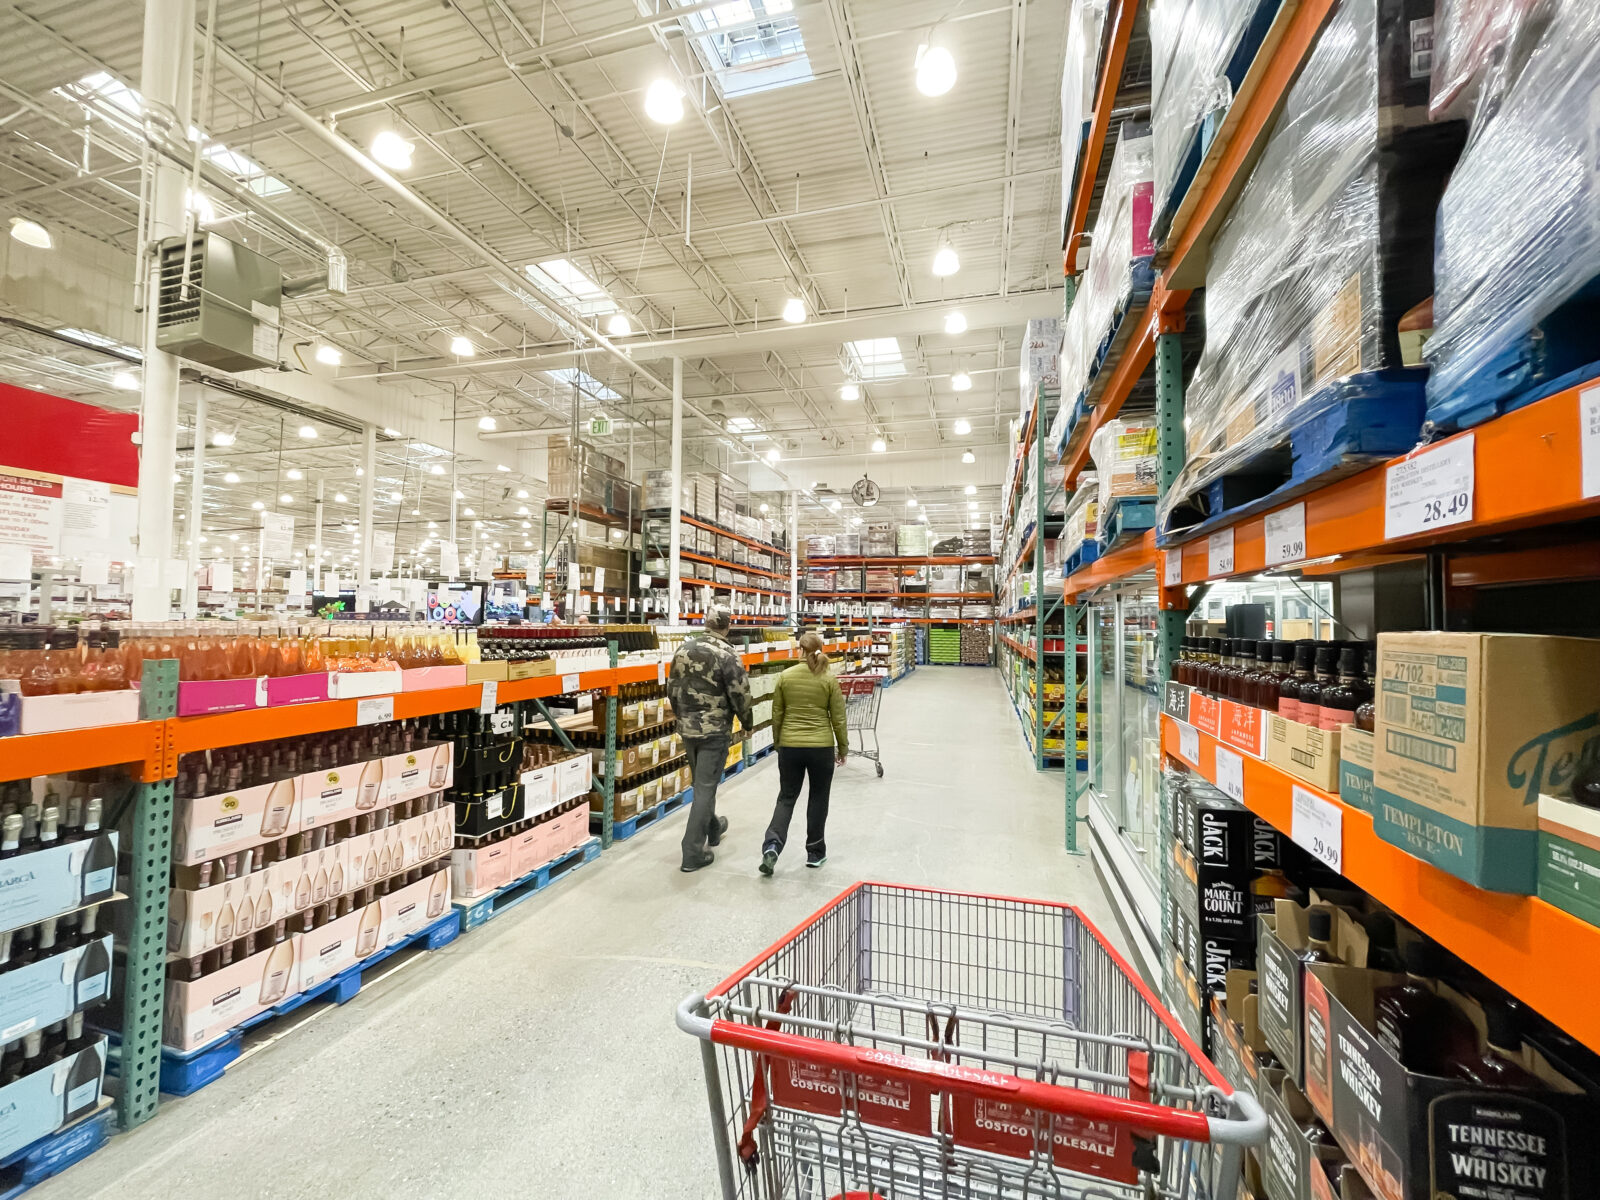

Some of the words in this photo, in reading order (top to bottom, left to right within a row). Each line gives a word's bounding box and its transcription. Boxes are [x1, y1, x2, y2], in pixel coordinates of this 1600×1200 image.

[592, 420, 608, 434] EXIT
[1423, 493, 1468, 523] 28.49
[1282, 541, 1303, 559] 59.99
[1394, 663, 1424, 683] 27102
[1231, 728, 1254, 743] JAPANESE
[1202, 813, 1228, 858] JACK
[1383, 803, 1464, 857] TEMPLETON
[1313, 837, 1338, 865] 29.99
[1204, 887, 1231, 901] MAKE
[1233, 891, 1243, 902] IT
[1204, 898, 1244, 914] COUNT
[1205, 940, 1231, 986] JACK
[1264, 952, 1289, 992] TENNESSEE
[1265, 972, 1289, 1012] WHISKEY
[1338, 1033, 1382, 1096] TENNESSEE
[790, 1079, 836, 1095] COSTCO
[1340, 1059, 1383, 1122] WHISKEY
[975, 1118, 1028, 1137] COSTCO
[1448, 1124, 1547, 1156] TENNESSEE
[1449, 1152, 1546, 1189] WHISKEY
